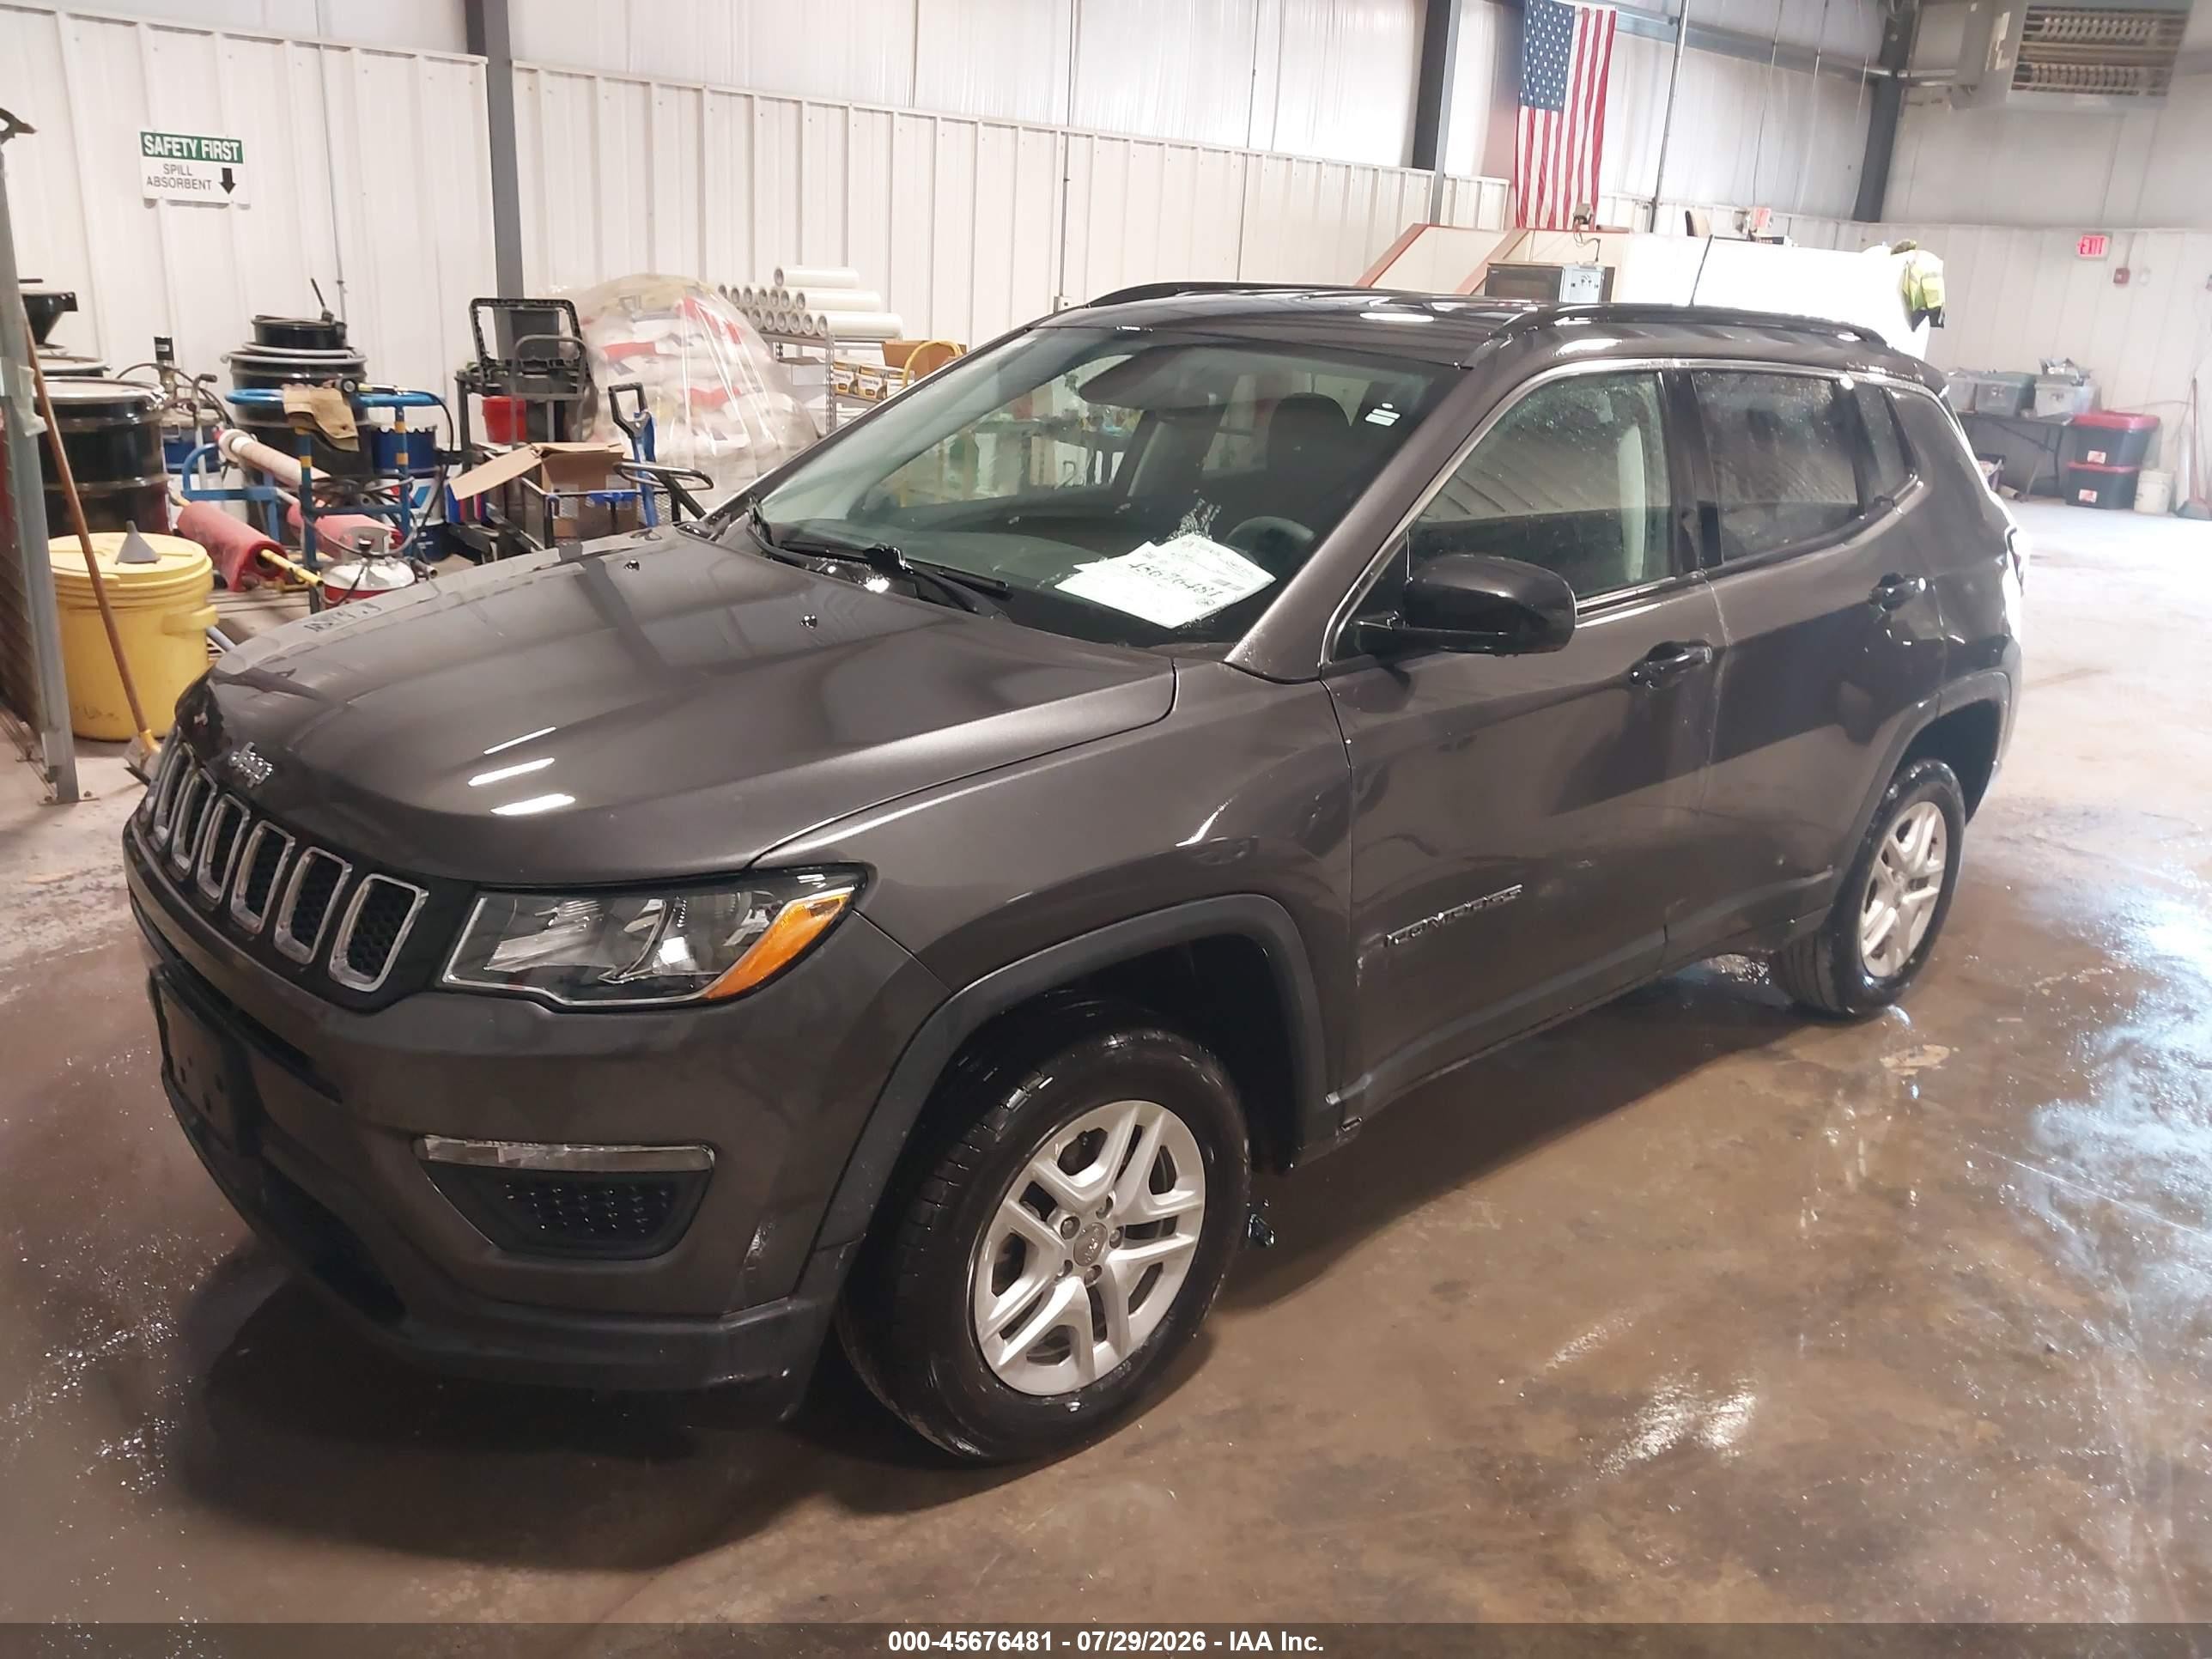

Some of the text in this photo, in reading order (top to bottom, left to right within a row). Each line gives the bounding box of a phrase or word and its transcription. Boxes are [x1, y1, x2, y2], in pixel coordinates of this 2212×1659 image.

[143, 134, 239, 161] SAFETY FIRST
[163, 163, 193, 176] SPILL
[146, 176, 211, 191] ABSORBENT
[2079, 236, 2104, 255] EXIT
